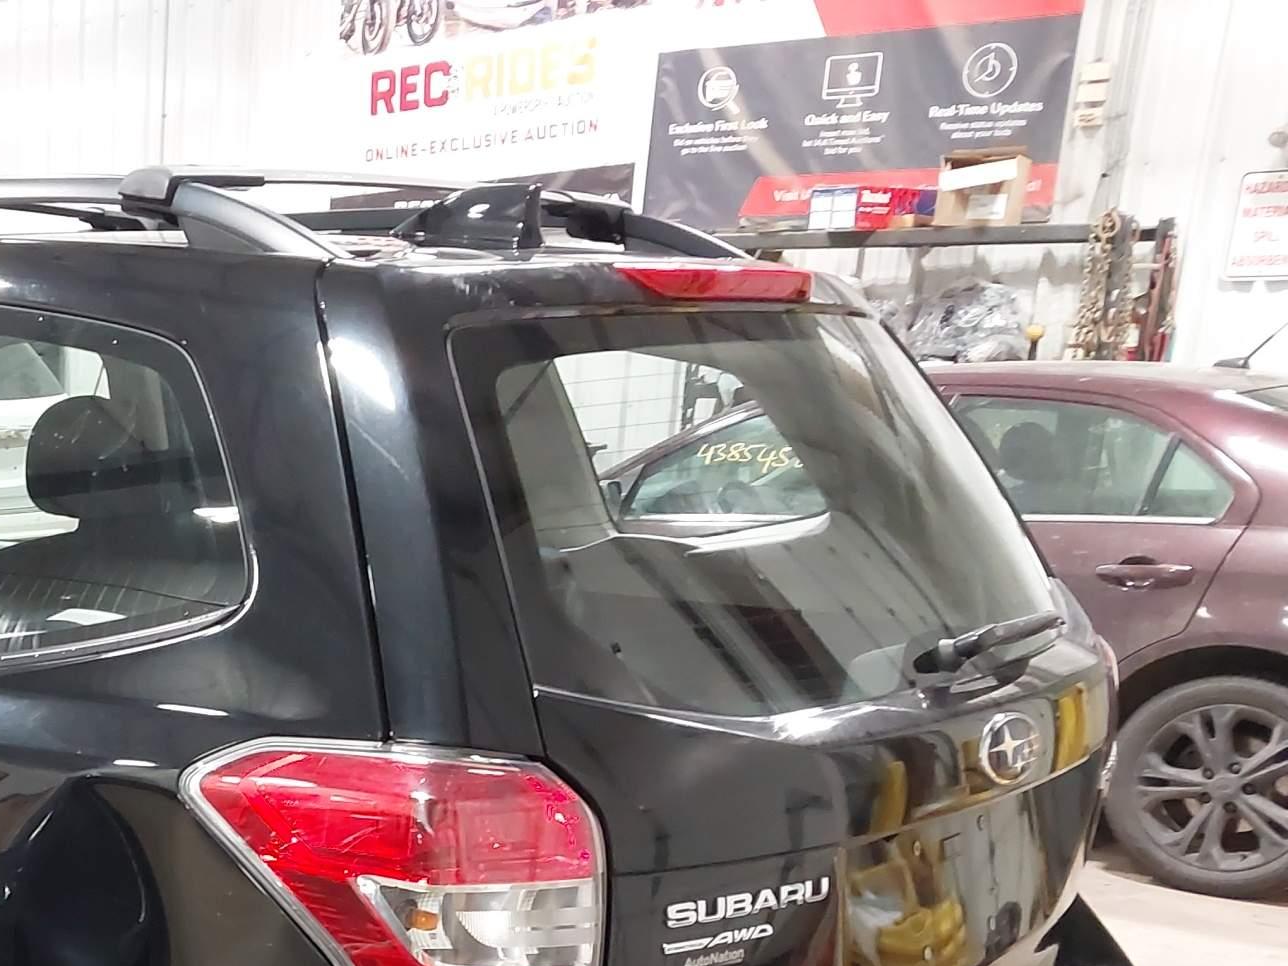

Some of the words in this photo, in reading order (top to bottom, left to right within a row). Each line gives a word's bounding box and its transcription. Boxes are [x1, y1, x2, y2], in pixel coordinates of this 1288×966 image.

[370, 60, 452, 116] REC
[804, 112, 839, 126] Quick
[840, 112, 861, 123] and
[862, 110, 890, 123] Easy
[928, 104, 988, 118] Real-Time
[990, 101, 1044, 116] Updates
[715, 119, 738, 132] First
[740, 117, 769, 130] Look
[365, 129, 518, 163] ONLINE-EXCLUSIVE
[524, 118, 600, 142] AUCTION
[665, 876, 830, 928] SUBARU
[708, 923, 775, 947] AWD
